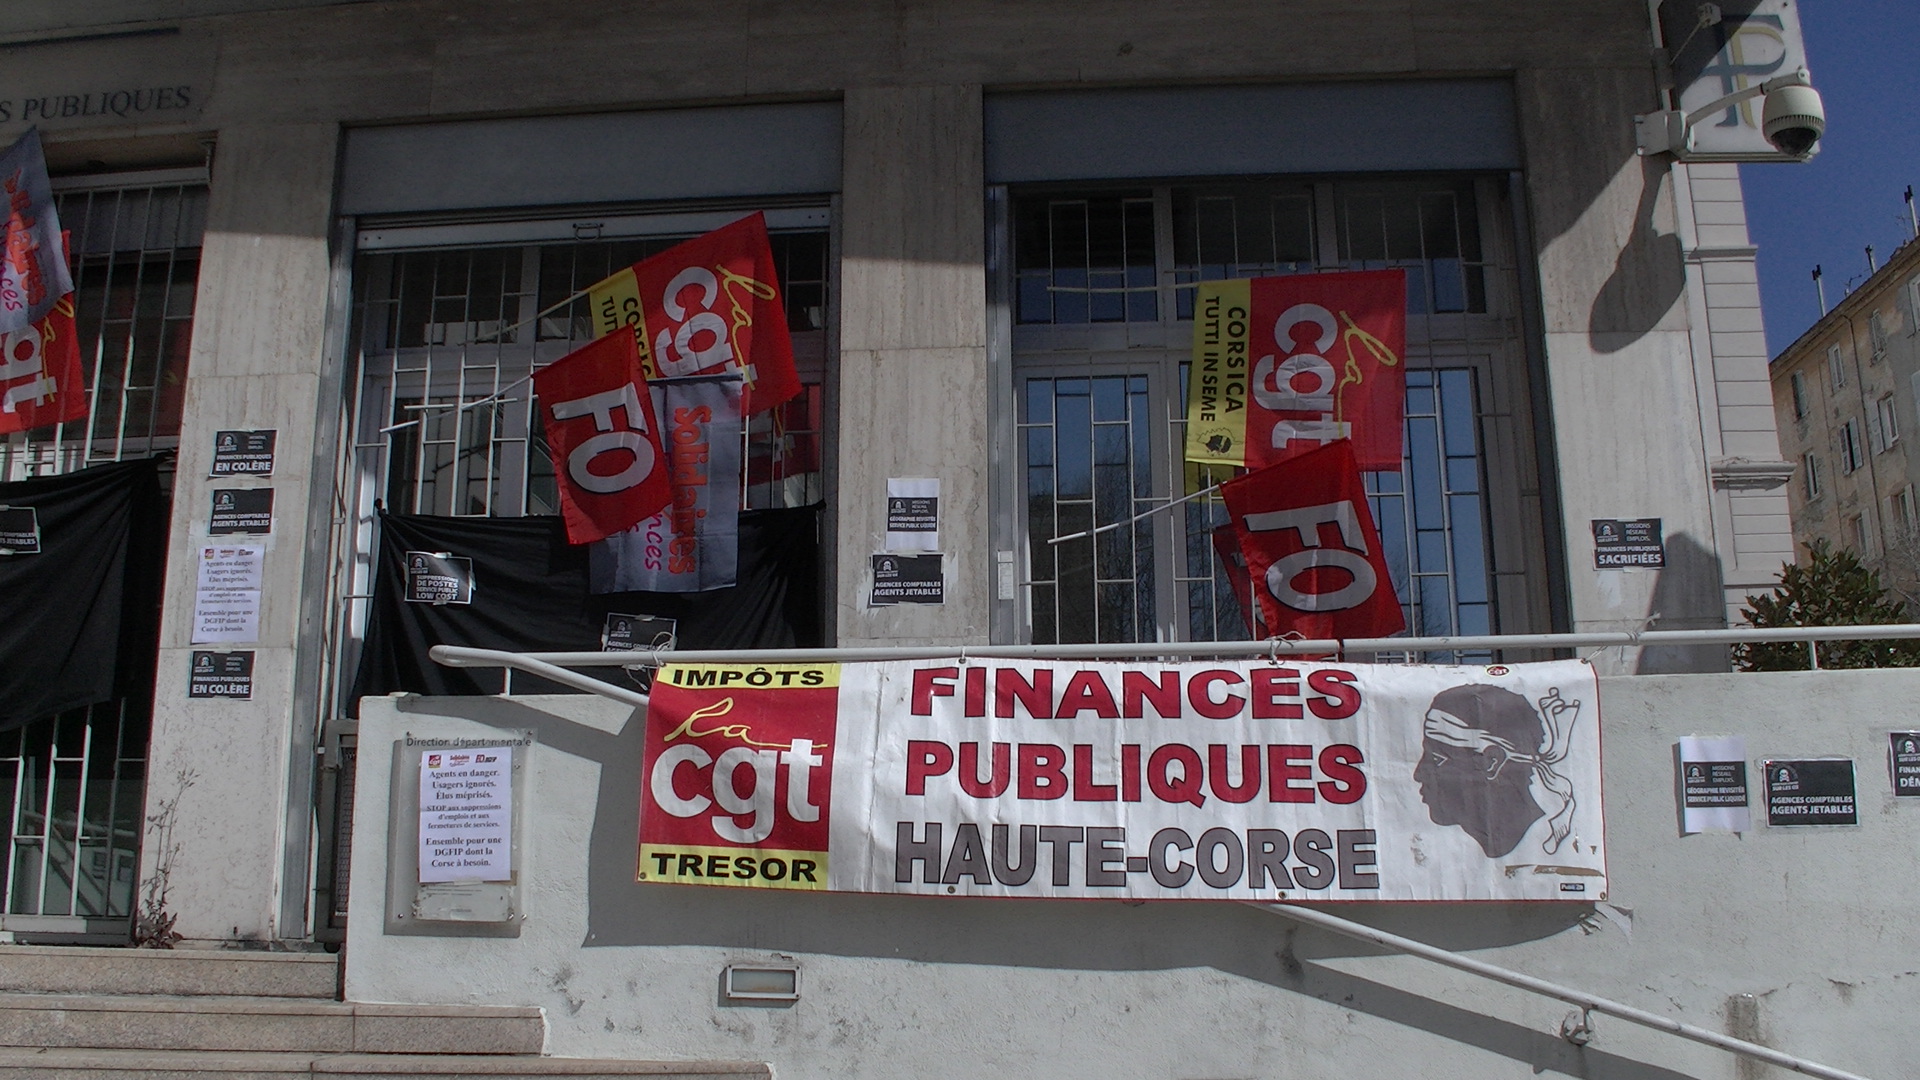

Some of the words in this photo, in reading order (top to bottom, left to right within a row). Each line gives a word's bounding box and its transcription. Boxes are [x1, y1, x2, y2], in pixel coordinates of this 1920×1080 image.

[22, 86, 191, 121] PUBLIQUES
[1205, 296, 1220, 345] TUTTI
[1225, 306, 1246, 413] CORSICA
[1252, 303, 1351, 449] cgt
[1200, 352, 1219, 421] INSEME
[552, 382, 656, 494] FO
[215, 462, 230, 472] EN
[232, 459, 271, 471] COLÈRE
[1242, 499, 1378, 613] FO
[1599, 552, 1662, 564] SACRIFIÉES
[428, 580, 459, 588] POSTES
[435, 592, 458, 600] COST
[874, 588, 904, 596] AGENTS
[905, 588, 941, 596] JETABLES
[607, 640, 632, 649] AGENCES
[672, 666, 825, 688] IMPÔTS
[193, 684, 208, 694] EN
[209, 682, 250, 694] COLÈRE
[911, 666, 1363, 721] FINANCES
[663, 696, 829, 749] la
[406, 737, 450, 747] Direction
[429, 771, 457, 779] Agents
[469, 769, 500, 778] danger.
[905, 739, 1368, 809] PUBLIQUES
[432, 781, 464, 790] Usagers
[465, 780, 497, 789] ignorés.
[436, 790, 454, 800] Élus
[455, 790, 493, 801] méprisés.
[650, 739, 823, 844] cgt
[1771, 796, 1804, 804] AGENCES
[1805, 795, 1853, 804] COMPTABLES
[1771, 805, 1808, 815] AGENTS
[1809, 804, 1854, 814] JETABLES
[426, 837, 464, 846] Ensemble
[466, 837, 485, 847] pour
[434, 848, 464, 857] DGFIP
[465, 848, 483, 856] dont
[485, 847, 493, 855] la
[895, 821, 1381, 890] HAUTE-CORSE
[431, 859, 455, 868] Corse
[456, 858, 462, 867] à
[463, 858, 491, 867] besoin.
[651, 852, 818, 884] TRESOR
